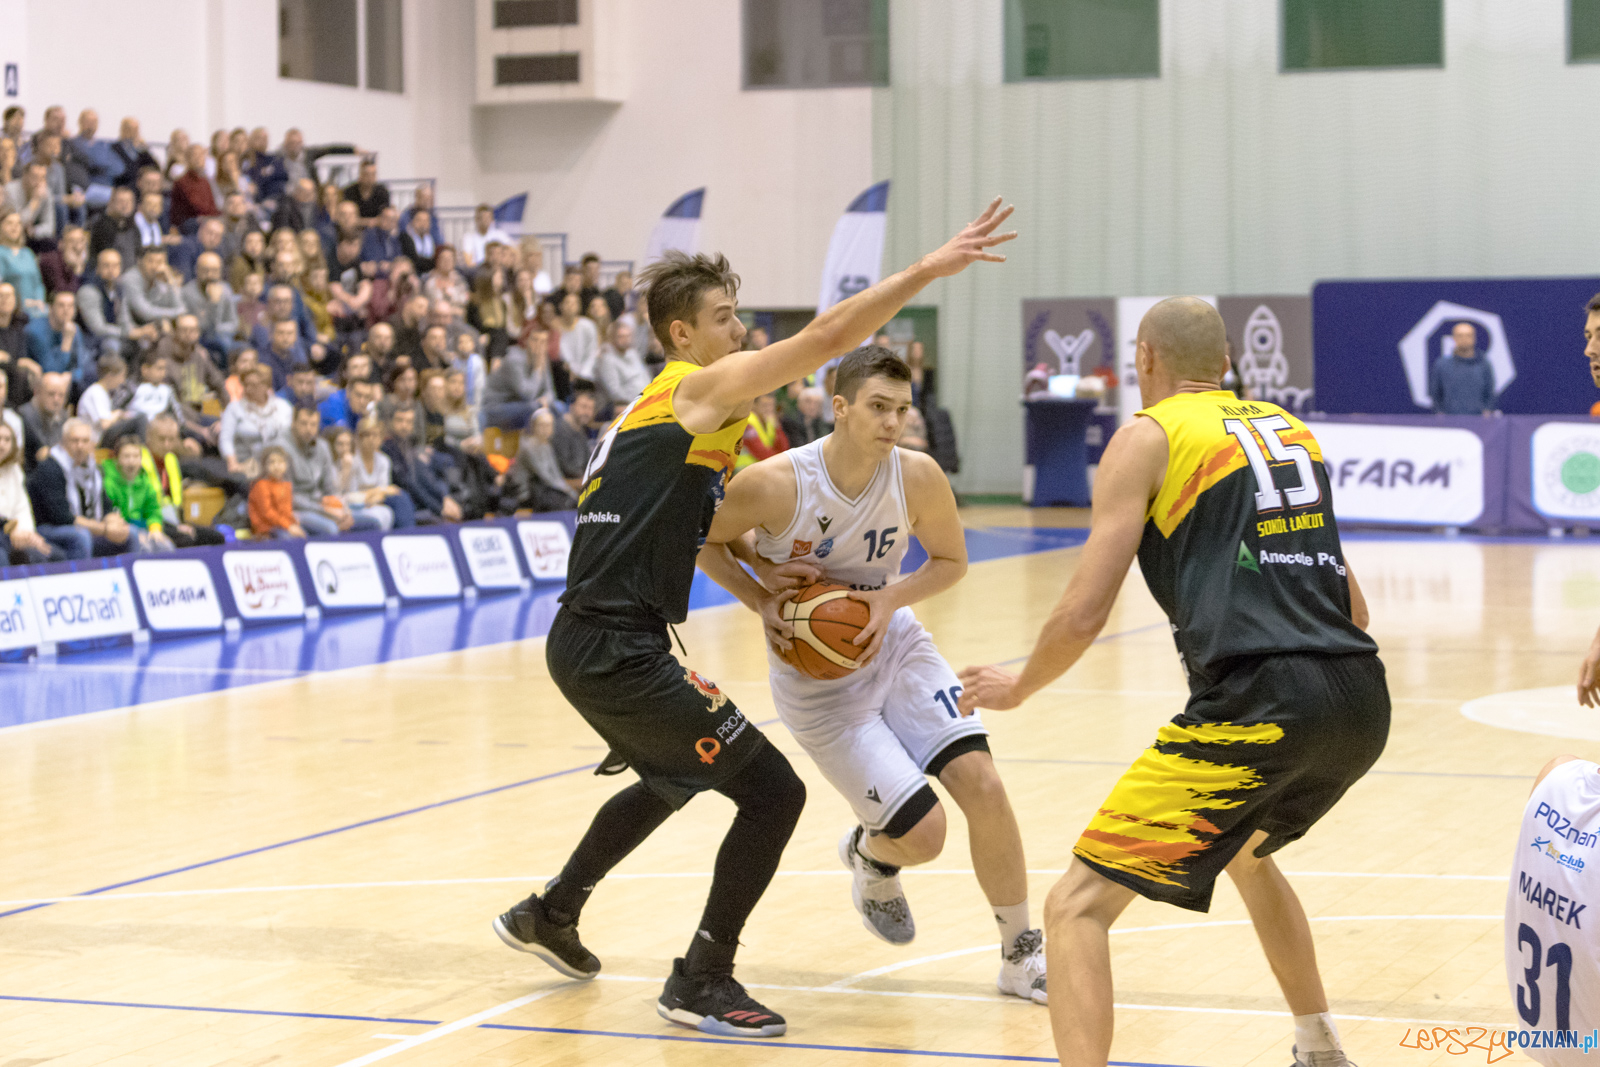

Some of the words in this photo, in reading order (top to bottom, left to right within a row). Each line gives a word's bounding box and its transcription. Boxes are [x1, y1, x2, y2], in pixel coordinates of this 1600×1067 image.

[1223, 413, 1322, 514] 15
[588, 511, 621, 524] Polska
[863, 526, 898, 562] 16
[1518, 870, 1587, 930] MAREK
[1517, 922, 1572, 1041] 31
